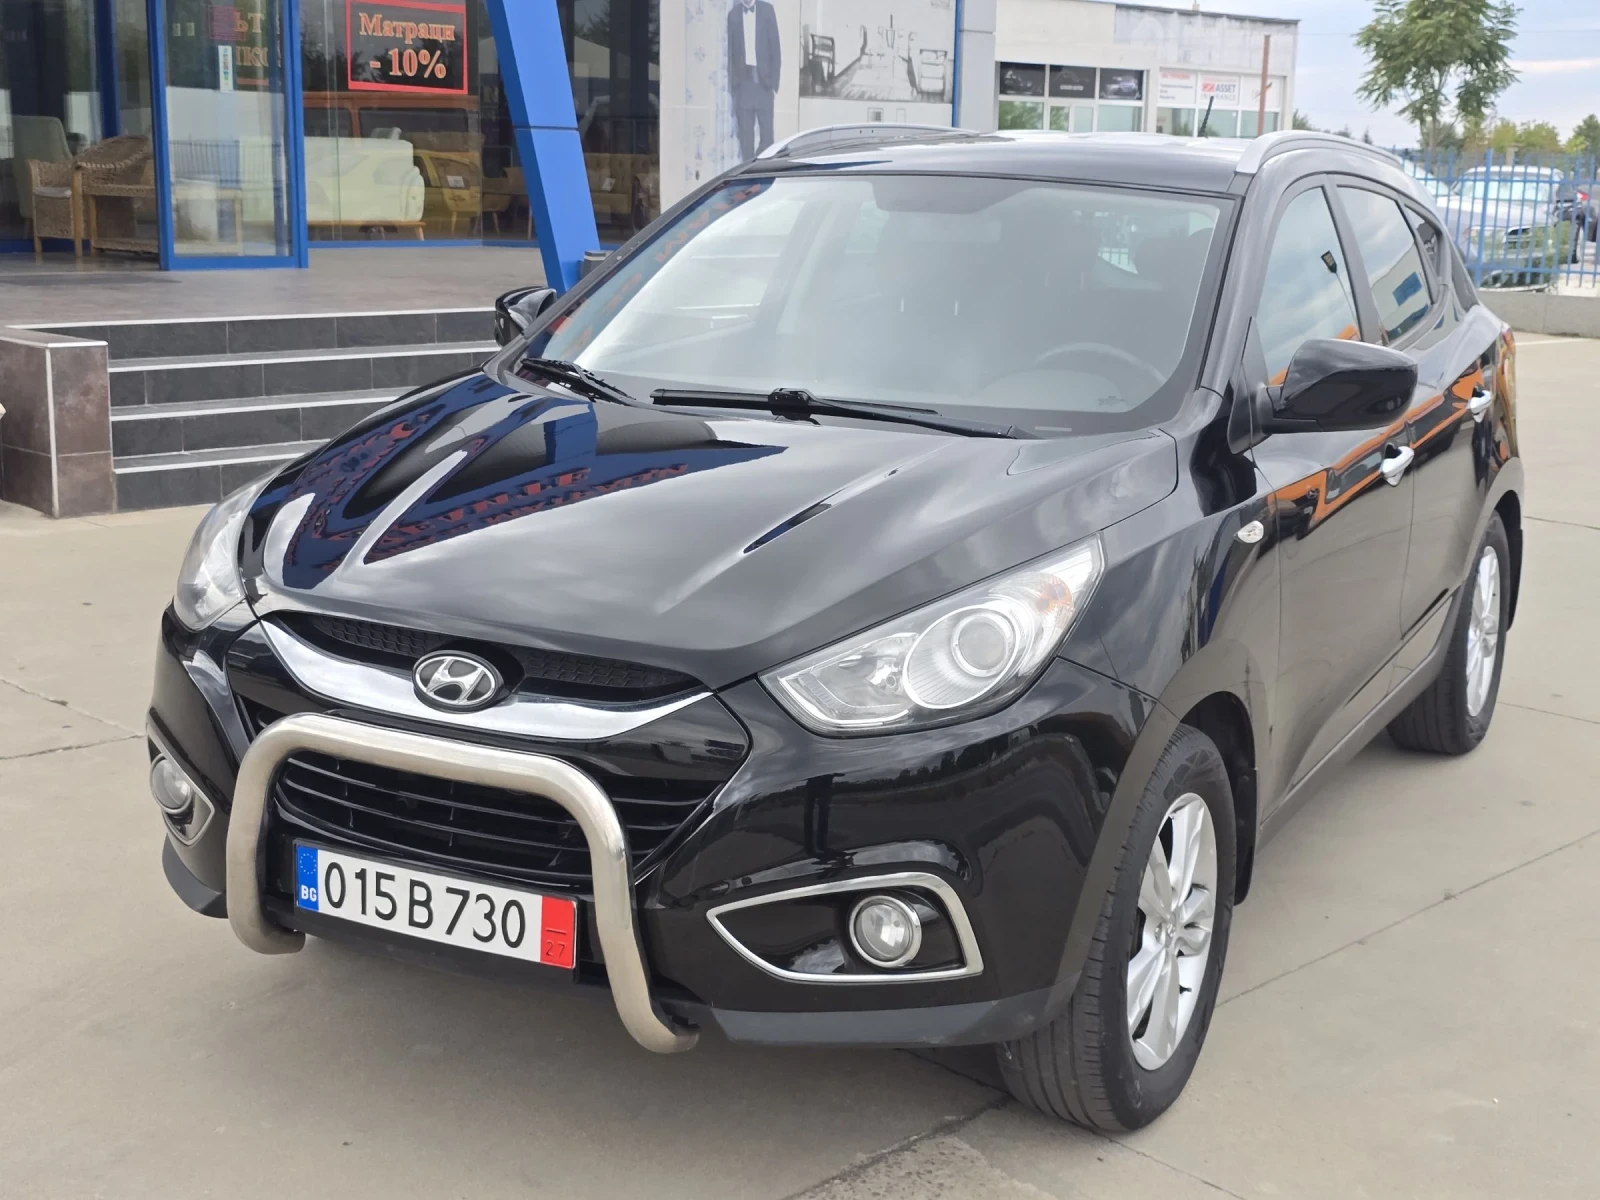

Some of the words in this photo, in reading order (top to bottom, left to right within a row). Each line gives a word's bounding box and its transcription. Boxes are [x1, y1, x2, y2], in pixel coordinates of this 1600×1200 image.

[359, 12, 456, 44] Матраци
[388, 47, 447, 79] 10%
[1201, 93, 1237, 101] INSRANCE
[1215, 83, 1236, 93] ASSET
[301, 884, 317, 902] BG
[324, 861, 526, 949] 015B730
[545, 939, 566, 960] 27
